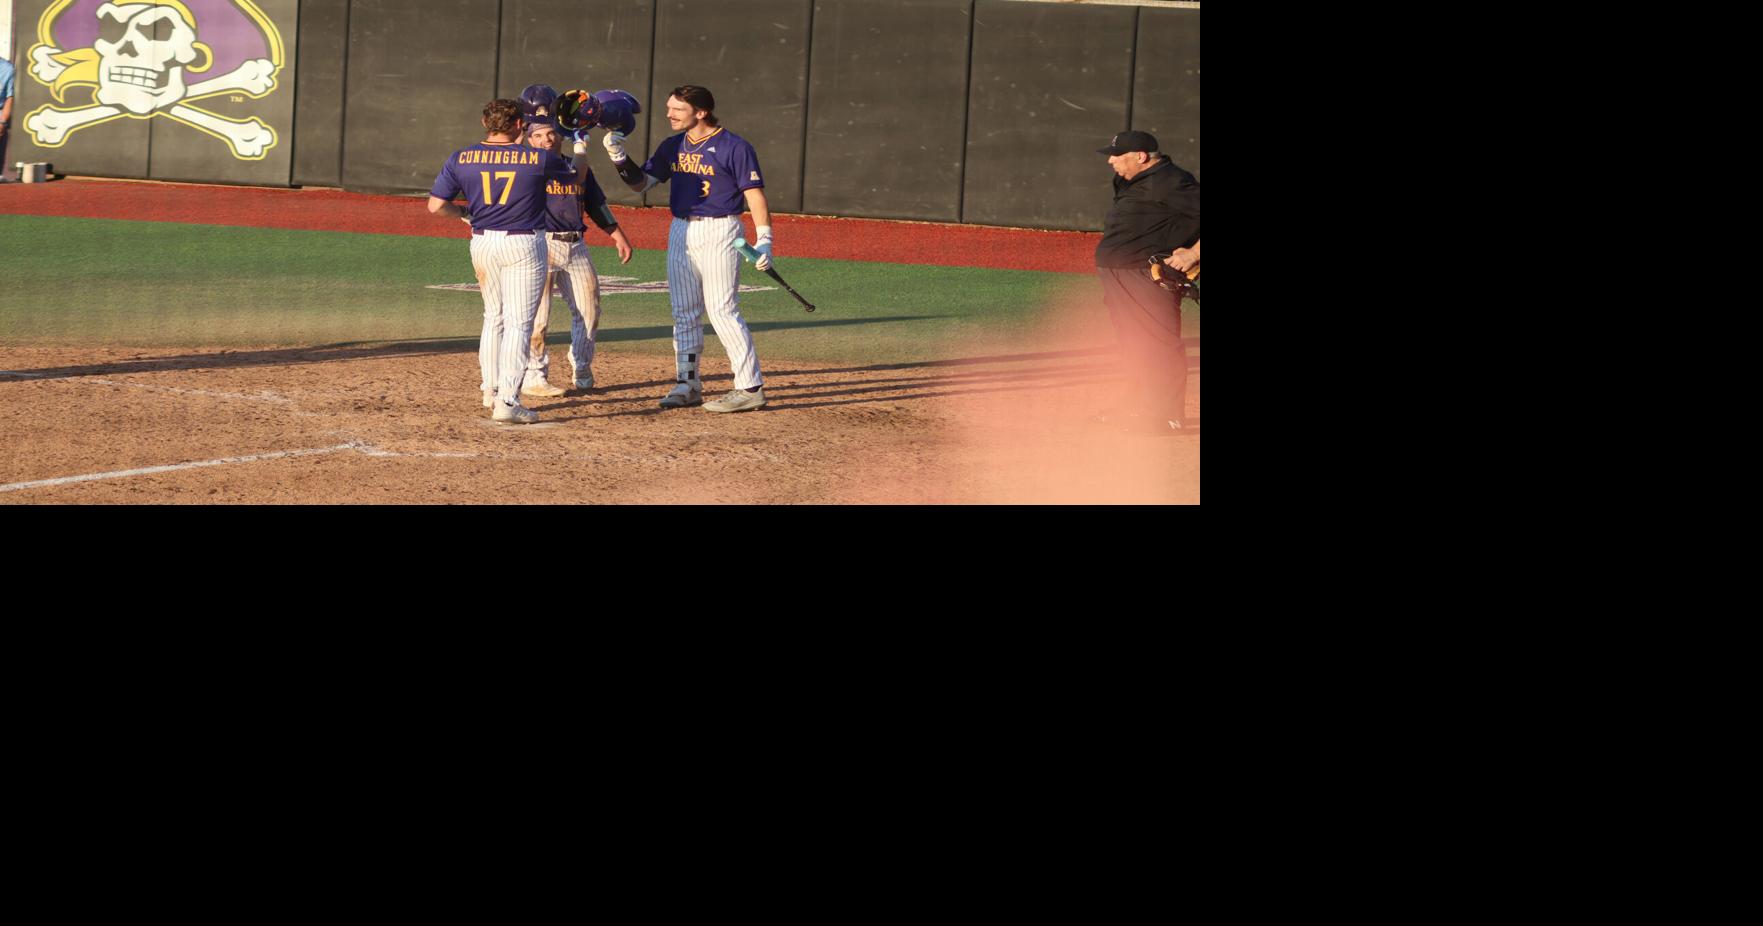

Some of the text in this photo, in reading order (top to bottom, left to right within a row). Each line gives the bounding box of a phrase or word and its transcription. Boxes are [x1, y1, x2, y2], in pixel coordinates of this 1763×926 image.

[459, 150, 540, 165] CUNNINGHAM
[678, 152, 704, 164] EAST
[671, 162, 715, 176] AROLINA
[480, 171, 516, 205] 17
[698, 180, 711, 198] 3
